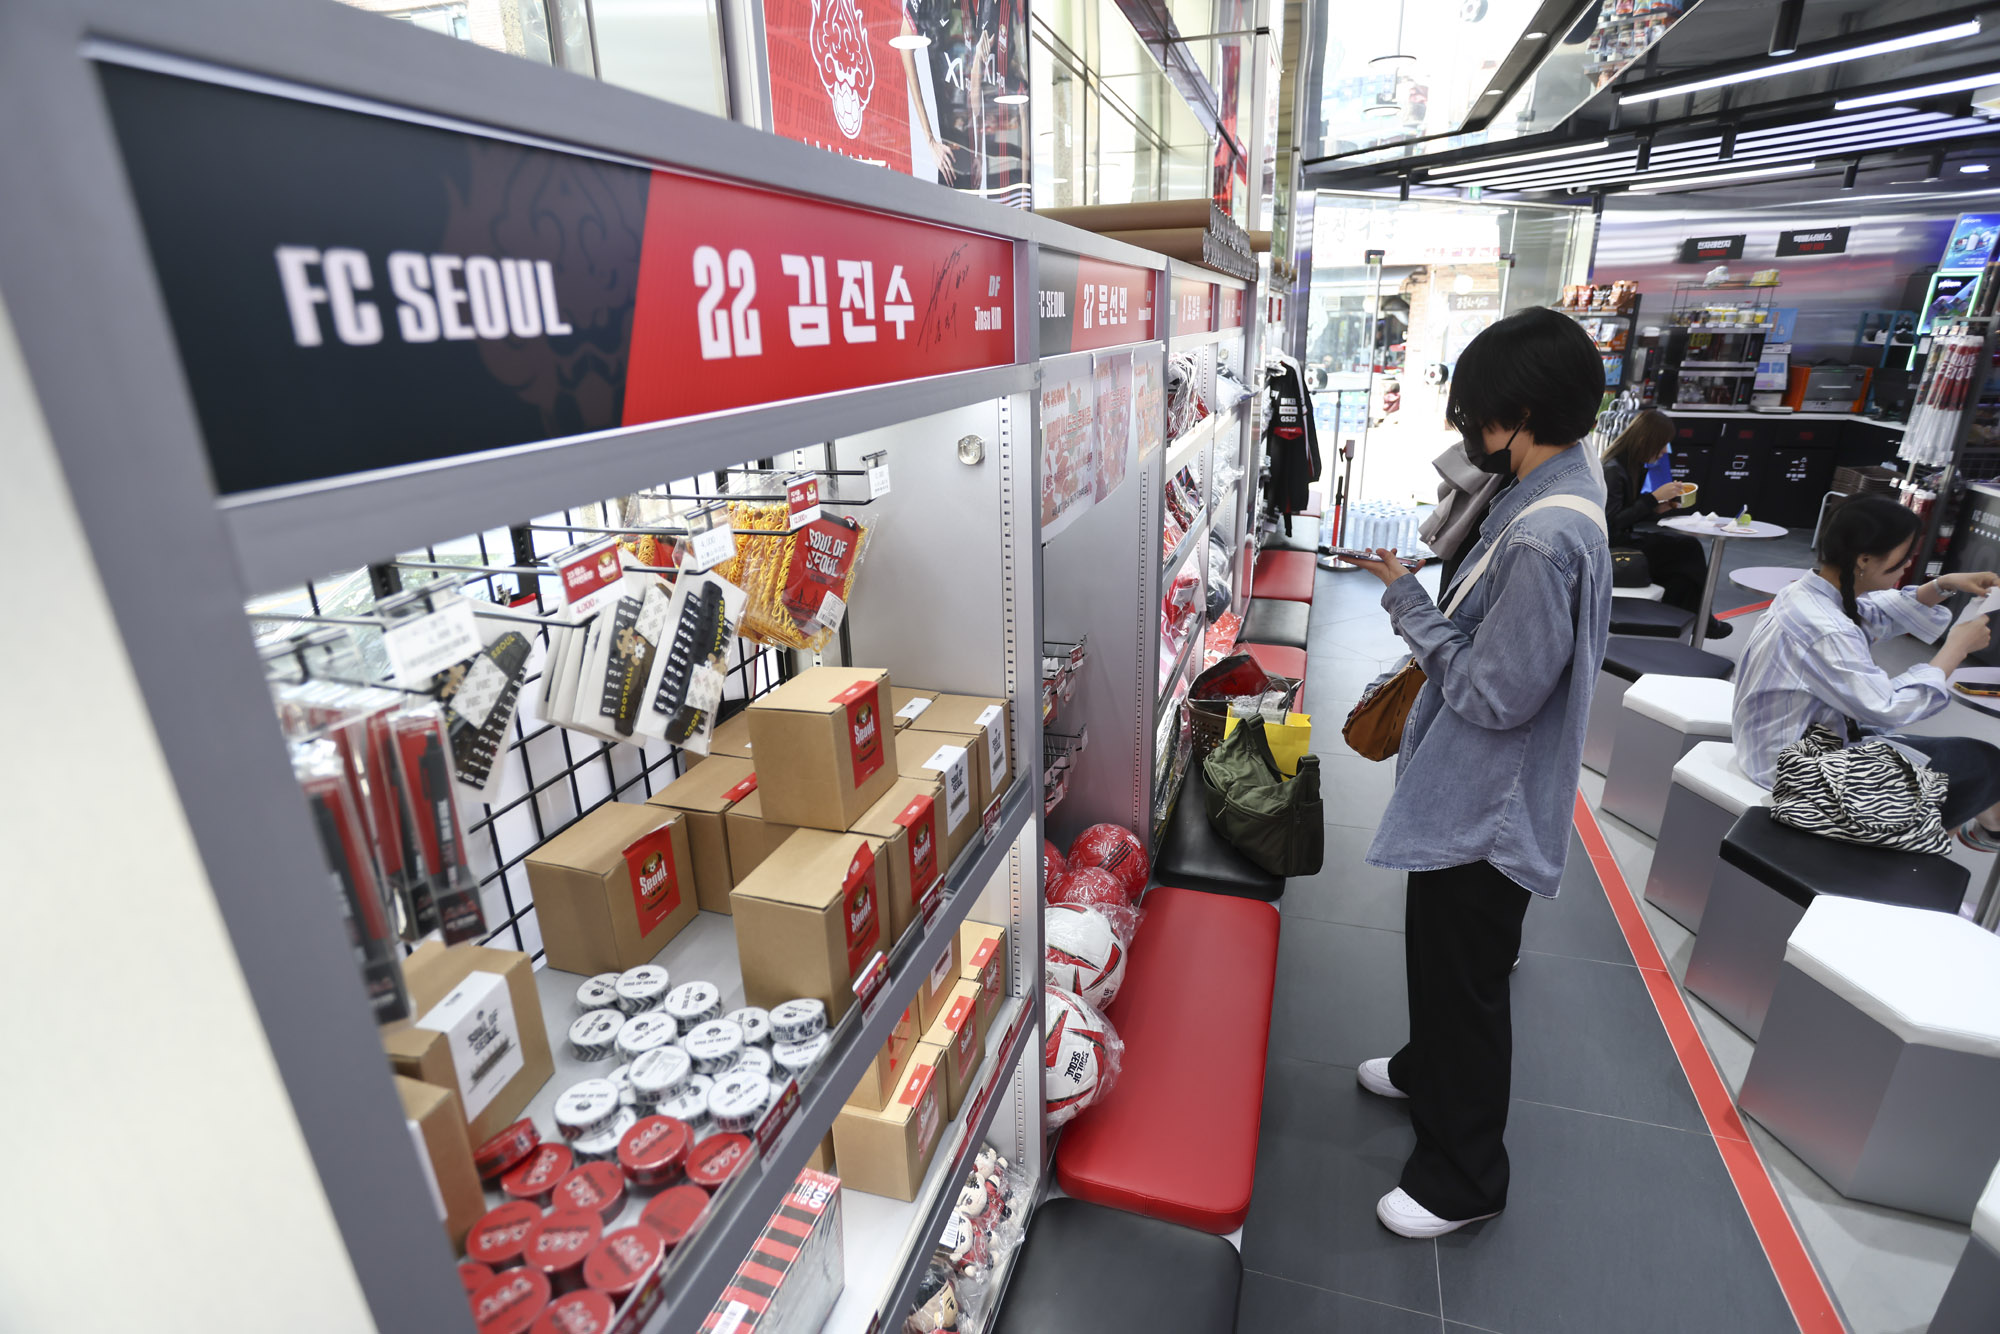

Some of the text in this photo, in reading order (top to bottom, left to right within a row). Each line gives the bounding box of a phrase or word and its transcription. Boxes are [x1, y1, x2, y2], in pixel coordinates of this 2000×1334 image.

[275, 245, 573, 348] FC SEOUL
[692, 245, 764, 360] 22
[780, 253, 916, 348] 김진수
[988, 275, 1001, 297] DF
[1046, 291, 1067, 318] SEOUL
[1083, 283, 1128, 329] 27 문선민
[806, 529, 849, 557] SOUL OF
[805, 550, 840, 577] SEOUL
[714, 600, 724, 651] FOOTBALL
[490, 635, 516, 658] SEOUL
[620, 667, 634, 719] FOOTBALL
[854, 715, 875, 746] Seoul
[914, 832, 931, 865] Seoul
[639, 860, 669, 897] Seoul
[851, 896, 872, 933] Seoul
[1064, 1051, 1082, 1078] SEOUL
[1073, 1051, 1090, 1085] SOUL OF
[808, 1181, 831, 1210] 300
